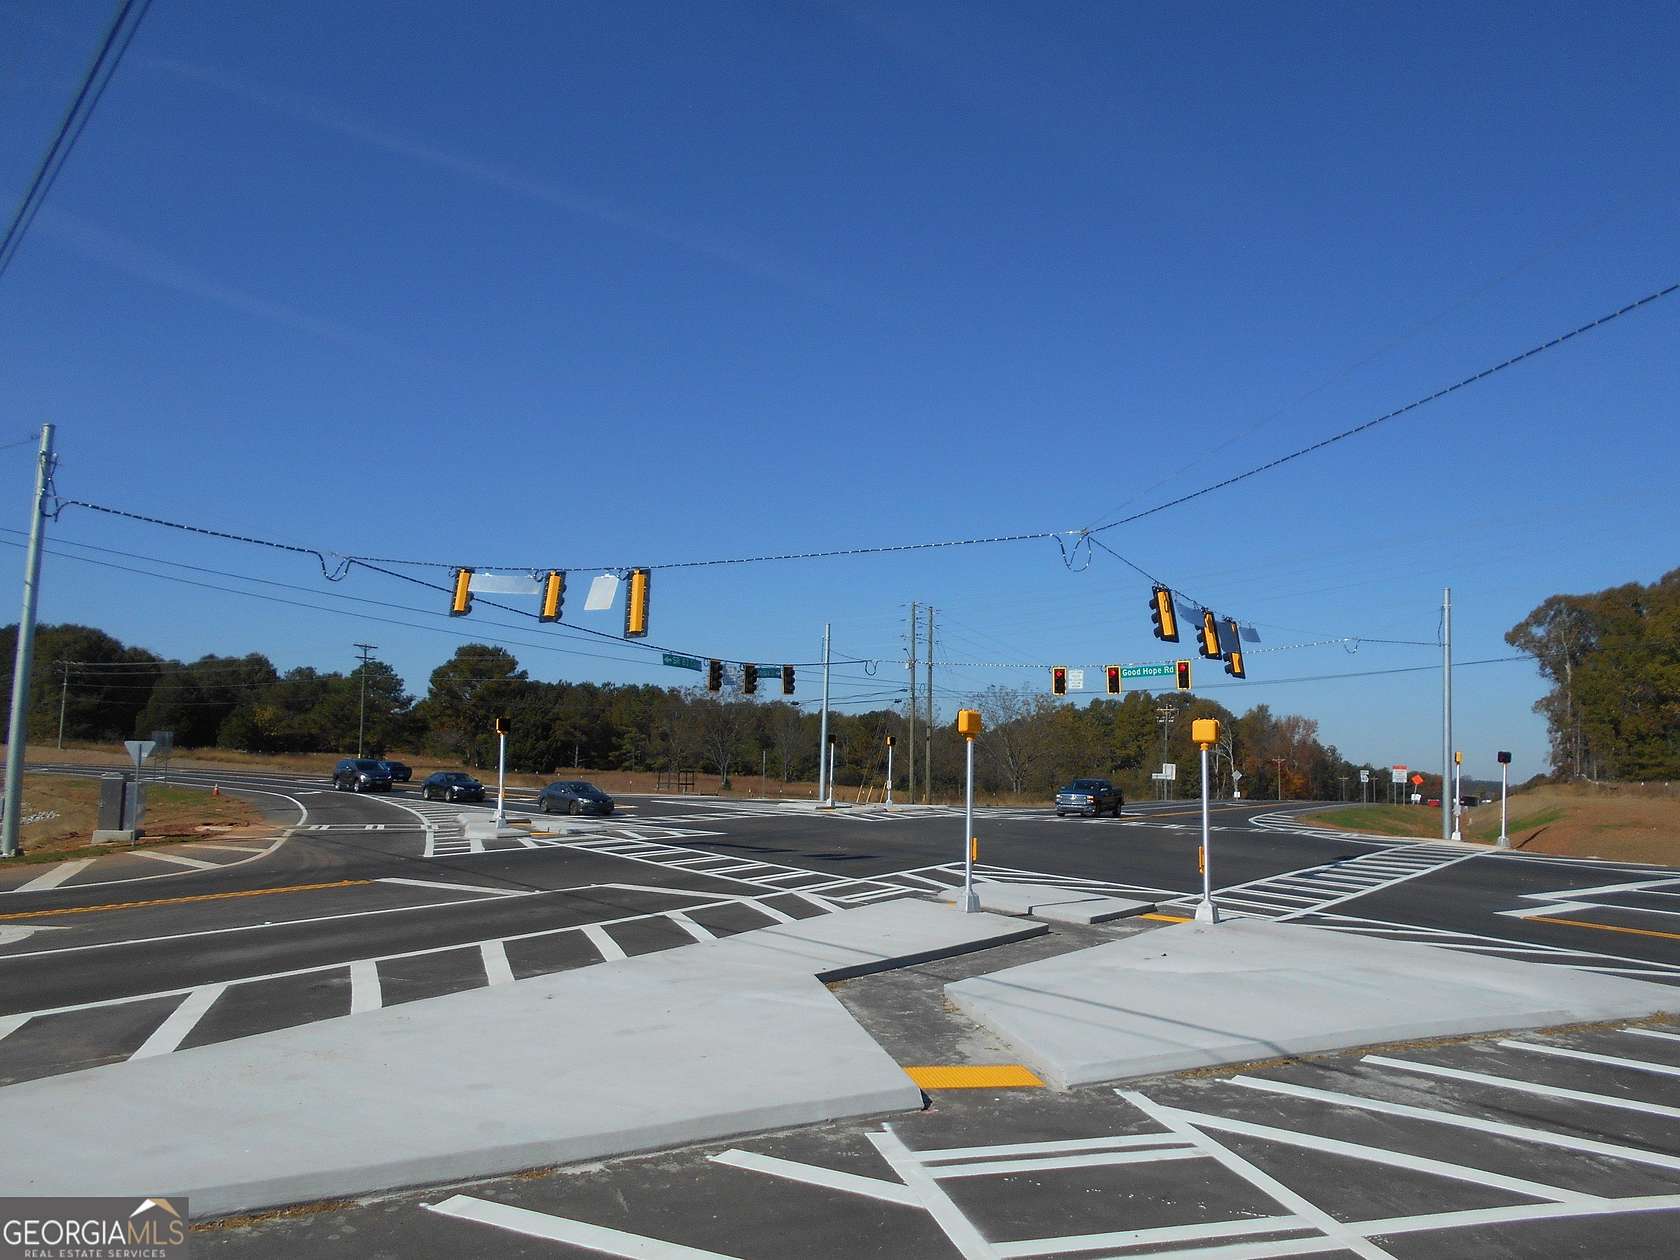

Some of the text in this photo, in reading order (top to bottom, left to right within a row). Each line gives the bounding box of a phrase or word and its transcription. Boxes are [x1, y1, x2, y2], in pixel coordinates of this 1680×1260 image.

[1122, 665, 1174, 676] Good Hope Rd
